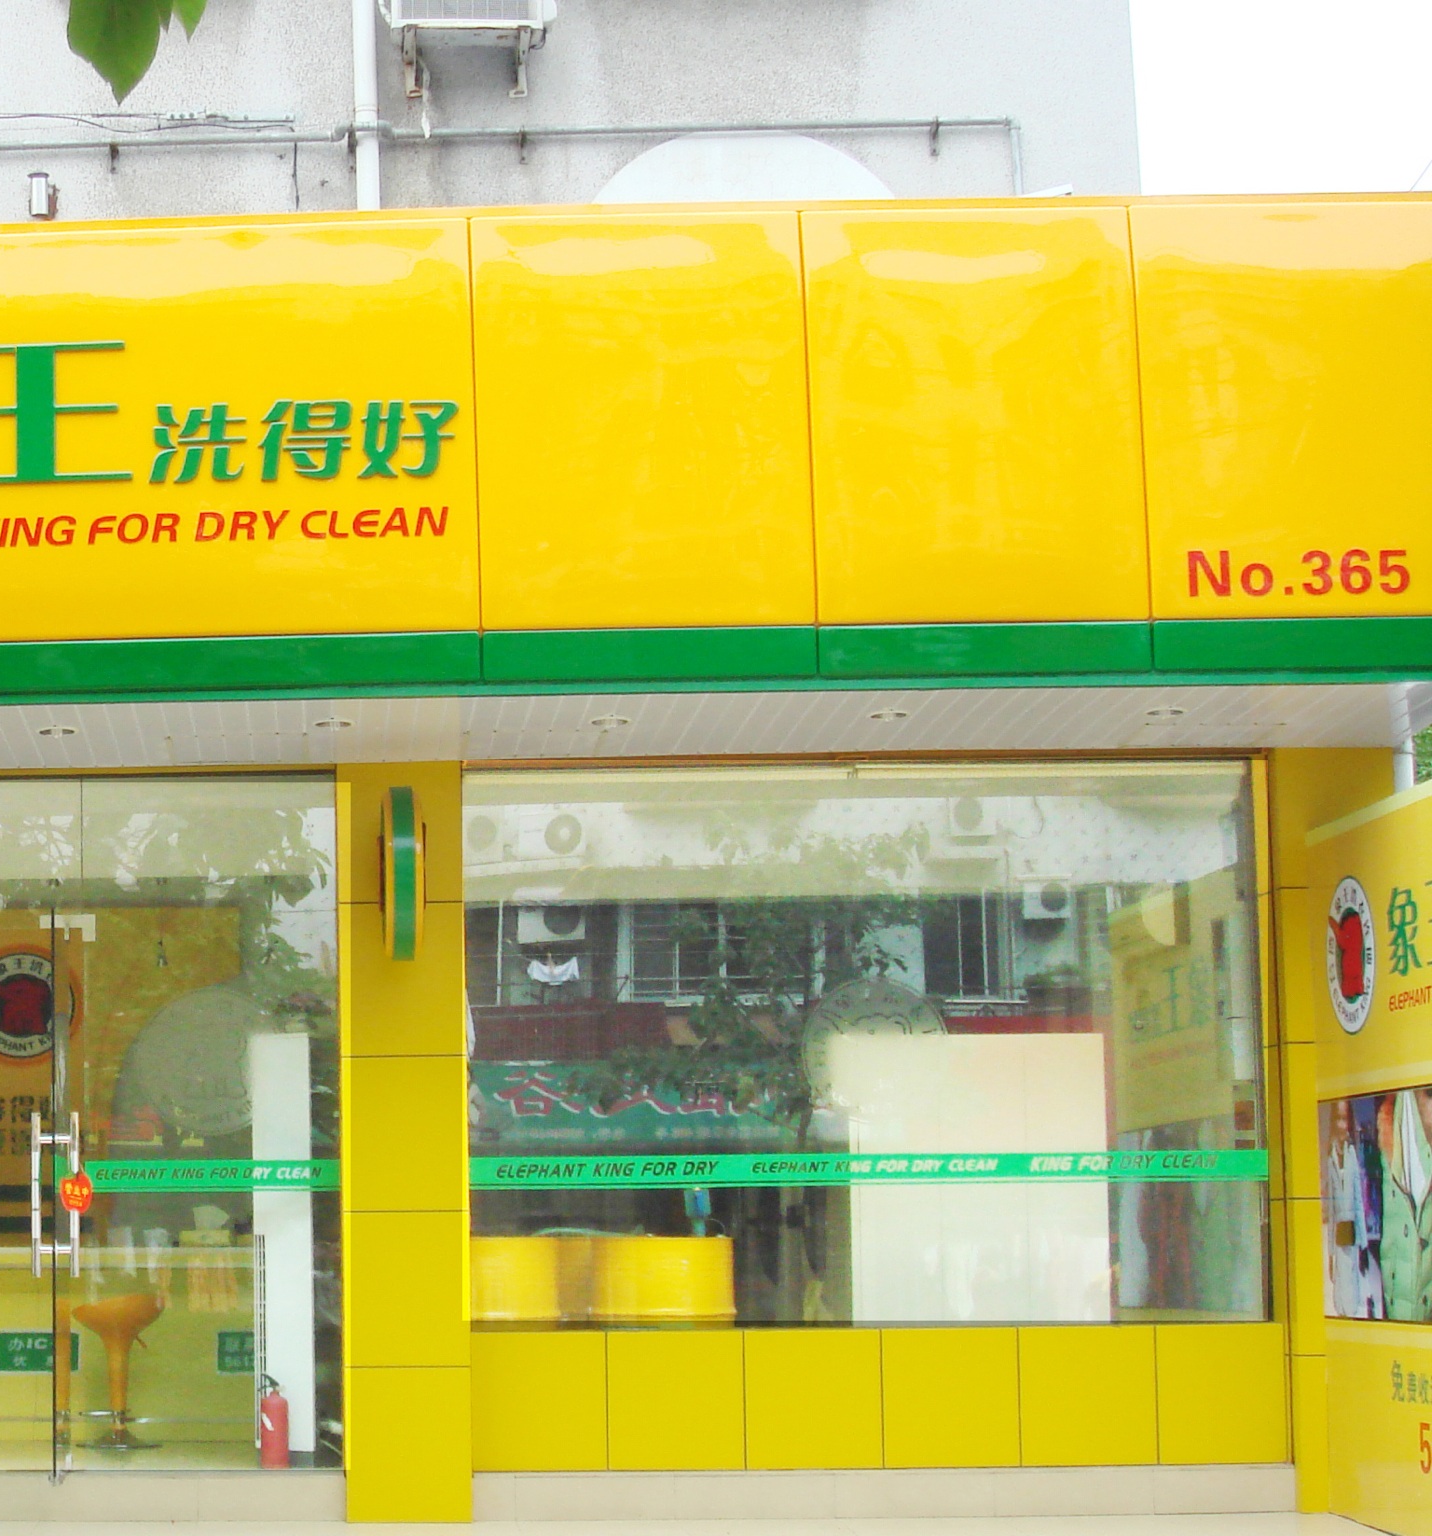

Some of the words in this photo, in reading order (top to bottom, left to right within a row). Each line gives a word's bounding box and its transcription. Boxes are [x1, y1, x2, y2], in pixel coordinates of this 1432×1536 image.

[87, 511, 181, 545] FOR
[193, 509, 291, 542] DRY
[299, 505, 450, 540] CLEAN
[1187, 549, 1411, 597] No.365
[1389, 985, 1432, 1012] ELEPHANT
[497, 1164, 587, 1179] ELEPHANT
[593, 1162, 635, 1177] KING
[641, 1161, 677, 1176] FOR
[682, 1161, 719, 1176] DRY
[751, 1161, 828, 1174] ELEPHANT
[834, 1160, 871, 1173] KING
[876, 1160, 908, 1173] FOR
[911, 1159, 942, 1173] DRY
[948, 1158, 999, 1172] CLEAN
[1029, 1156, 1073, 1172] KING
[1078, 1155, 1113, 1171] FOR
[1119, 1155, 1156, 1170] DRY
[1161, 1154, 1219, 1169] CLEAN
[96, 1168, 167, 1181] ELEPHANT
[171, 1167, 205, 1180] KING
[209, 1167, 237, 1179] FOR
[242, 1167, 271, 1180] DRY
[276, 1166, 322, 1180] CLEAN
